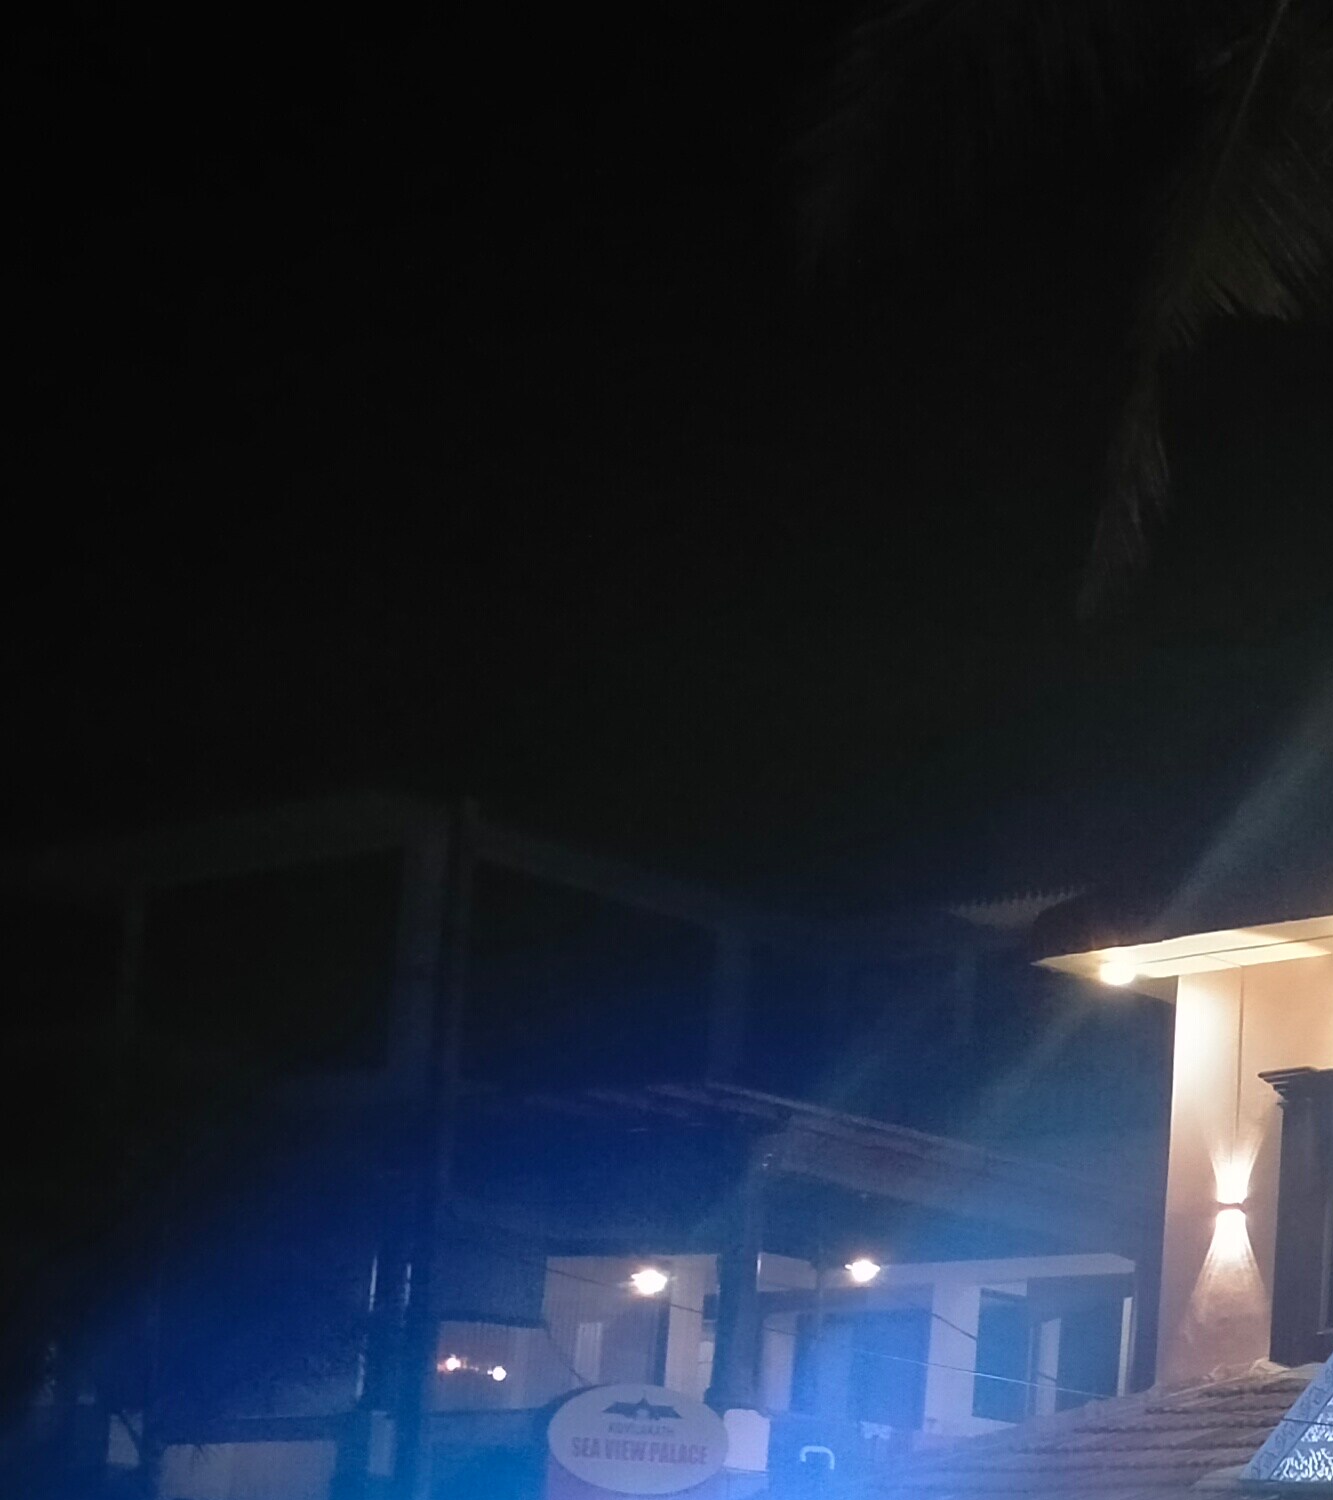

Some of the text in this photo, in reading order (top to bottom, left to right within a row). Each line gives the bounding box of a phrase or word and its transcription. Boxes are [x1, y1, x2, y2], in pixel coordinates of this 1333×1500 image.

[572, 1437, 708, 1465] SEA VIEW PALACE
